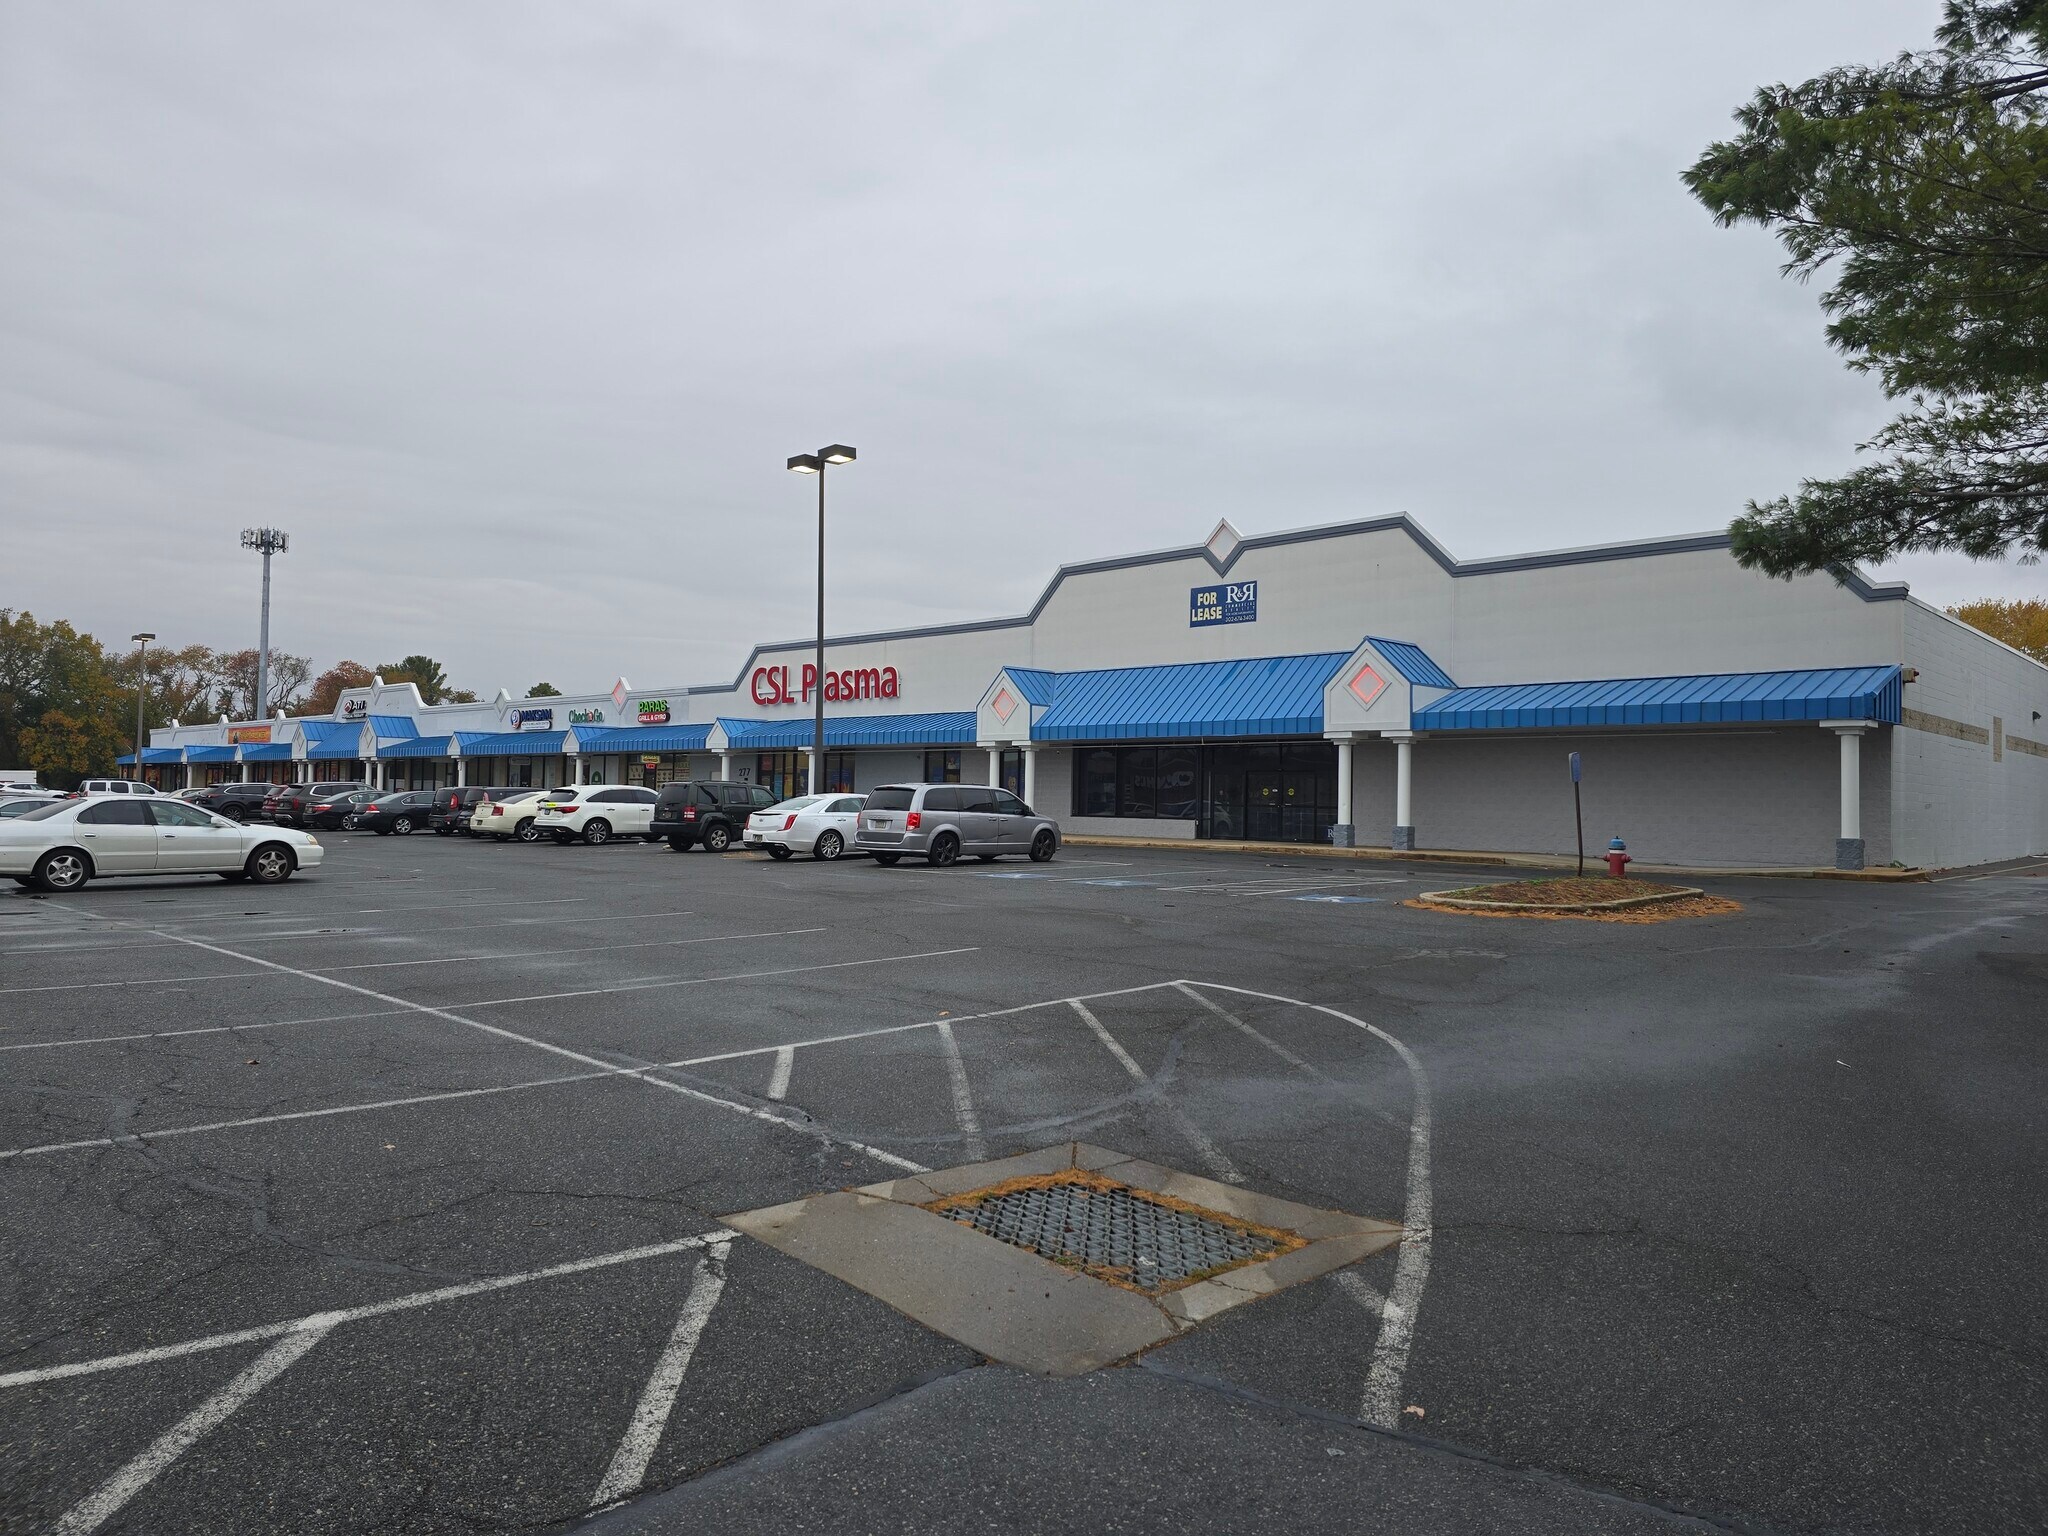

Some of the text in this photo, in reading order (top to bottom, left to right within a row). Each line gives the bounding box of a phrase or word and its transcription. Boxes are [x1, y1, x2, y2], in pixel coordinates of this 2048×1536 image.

[1197, 592, 1217, 606] FOR
[1191, 606, 1222, 622] LEASE
[751, 664, 898, 706] CSL Pasma
[638, 700, 668, 712] PARAS
[569, 708, 587, 723] Check
[739, 768, 750, 776] 277
